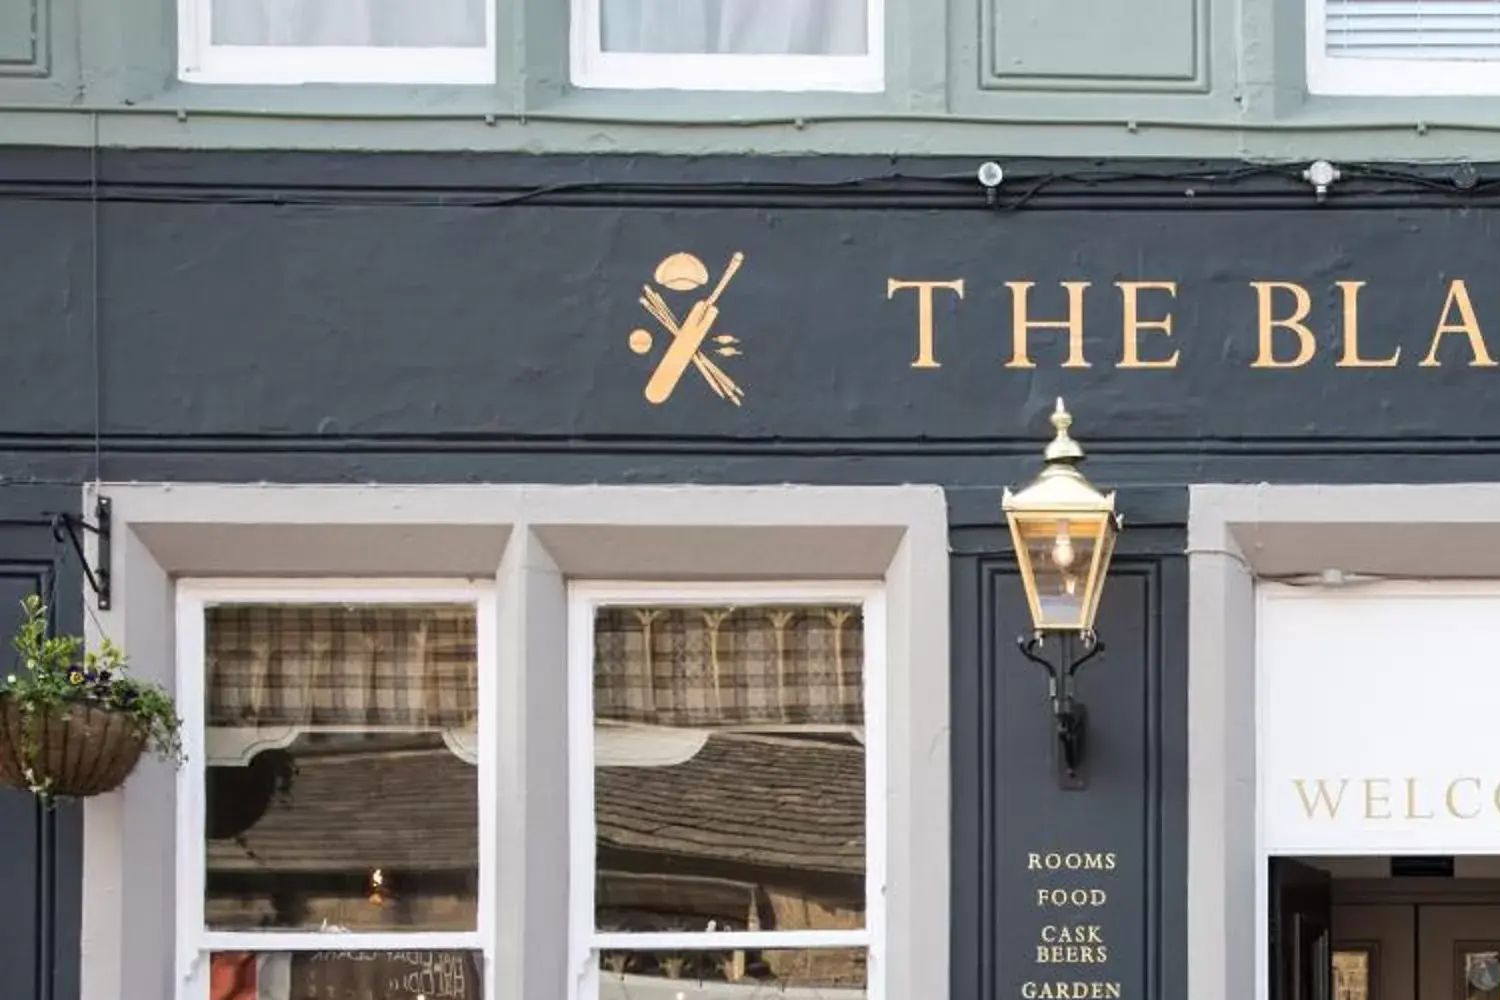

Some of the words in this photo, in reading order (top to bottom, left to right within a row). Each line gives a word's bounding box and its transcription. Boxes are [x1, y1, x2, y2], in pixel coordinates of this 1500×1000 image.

[887, 278, 1179, 369] THE
[1027, 852, 1117, 871] ROOMS
[1036, 888, 1107, 908] FOOD
[1041, 924, 1104, 944] CASK
[1035, 945, 1109, 964] BEERS
[1021, 981, 1122, 1000] GARDEN
